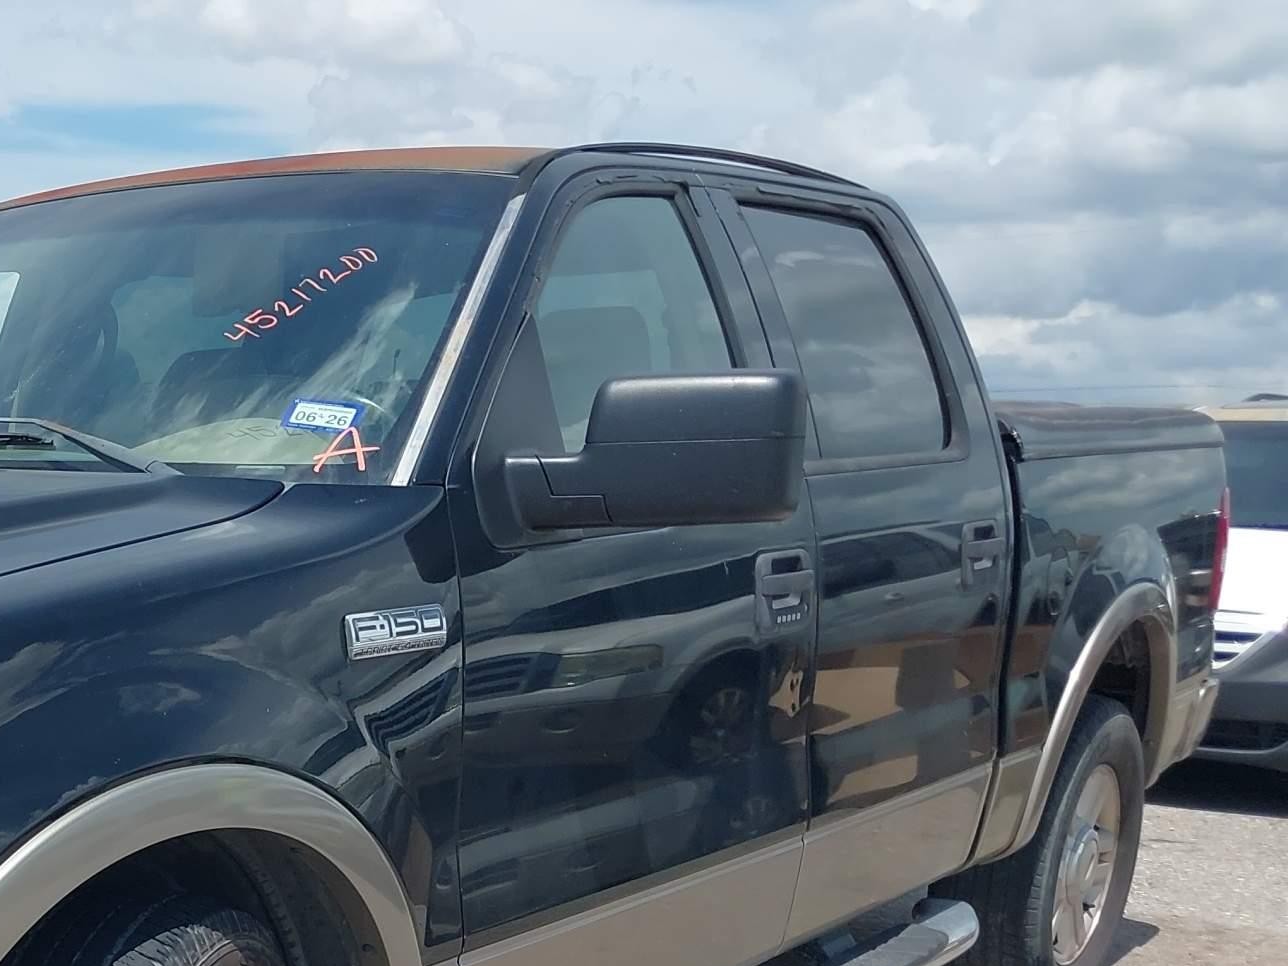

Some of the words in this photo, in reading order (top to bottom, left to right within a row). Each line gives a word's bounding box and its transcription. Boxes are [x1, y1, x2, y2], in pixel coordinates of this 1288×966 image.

[223, 248, 378, 341] 45217200
[295, 411, 316, 422] 06
[325, 414, 349, 426] 26
[313, 426, 381, 472] A
